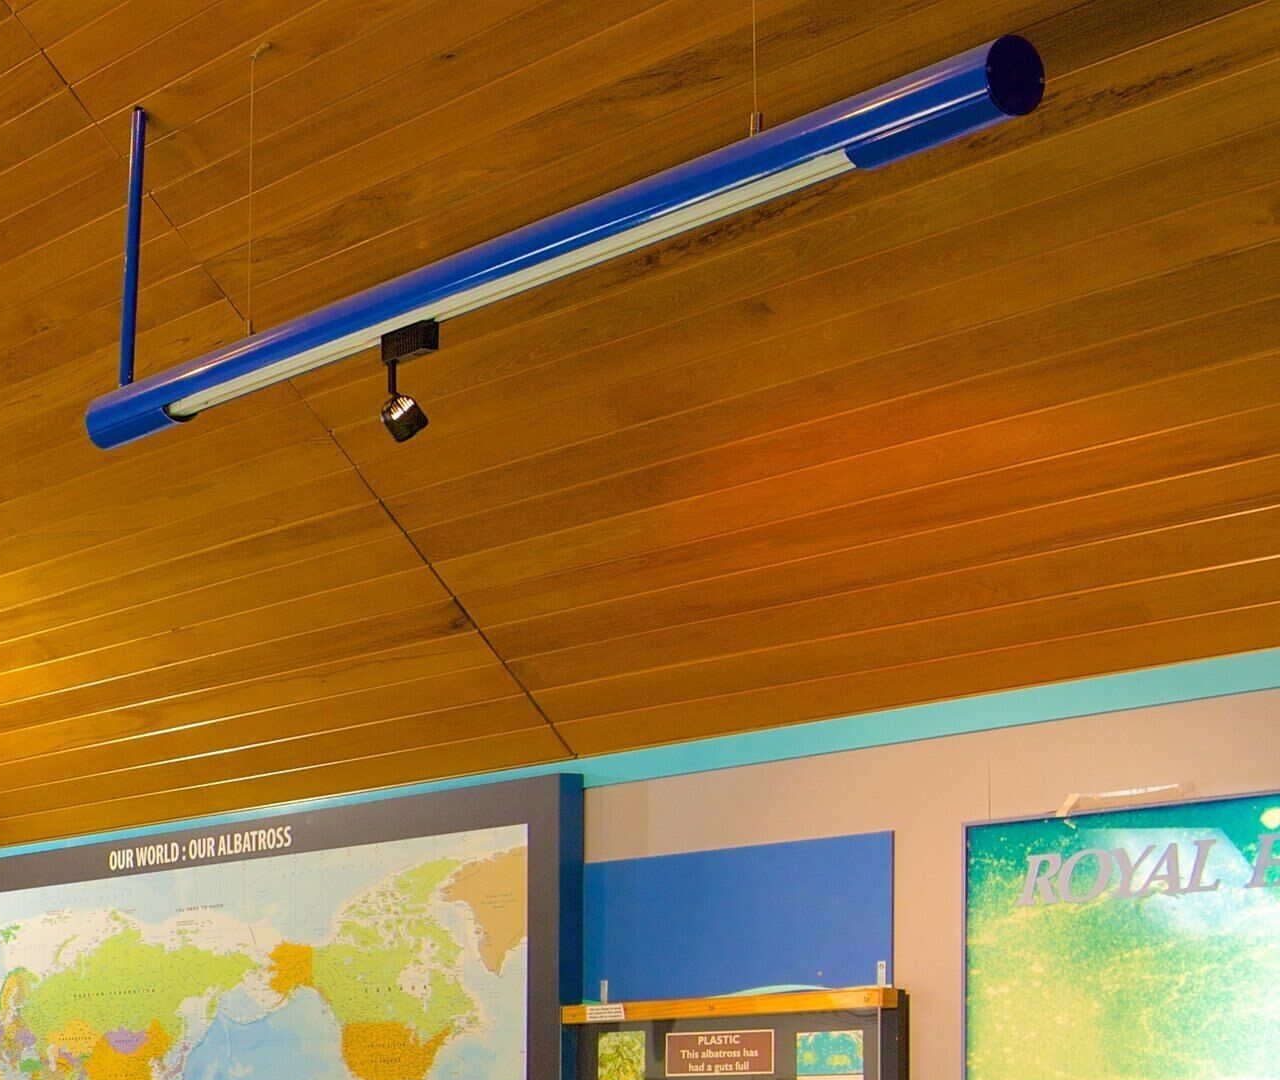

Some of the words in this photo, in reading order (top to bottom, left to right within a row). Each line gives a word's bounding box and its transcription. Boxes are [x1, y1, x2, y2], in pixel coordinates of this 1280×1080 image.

[109, 849, 134, 871] OUR
[136, 842, 179, 867] WORLD
[189, 837, 215, 859] OUR
[218, 825, 292, 856] ALBATROSS
[1015, 839, 1220, 908] ROYAL
[364, 984, 428, 994] CANADA
[697, 1034, 740, 1046] PLASTIC
[680, 1049, 699, 1059] This
[700, 1049, 741, 1059] albatross
[743, 1048, 759, 1058] has
[688, 1062, 705, 1072] had
[714, 1062, 733, 1073] guts
[735, 1060, 749, 1071] full
